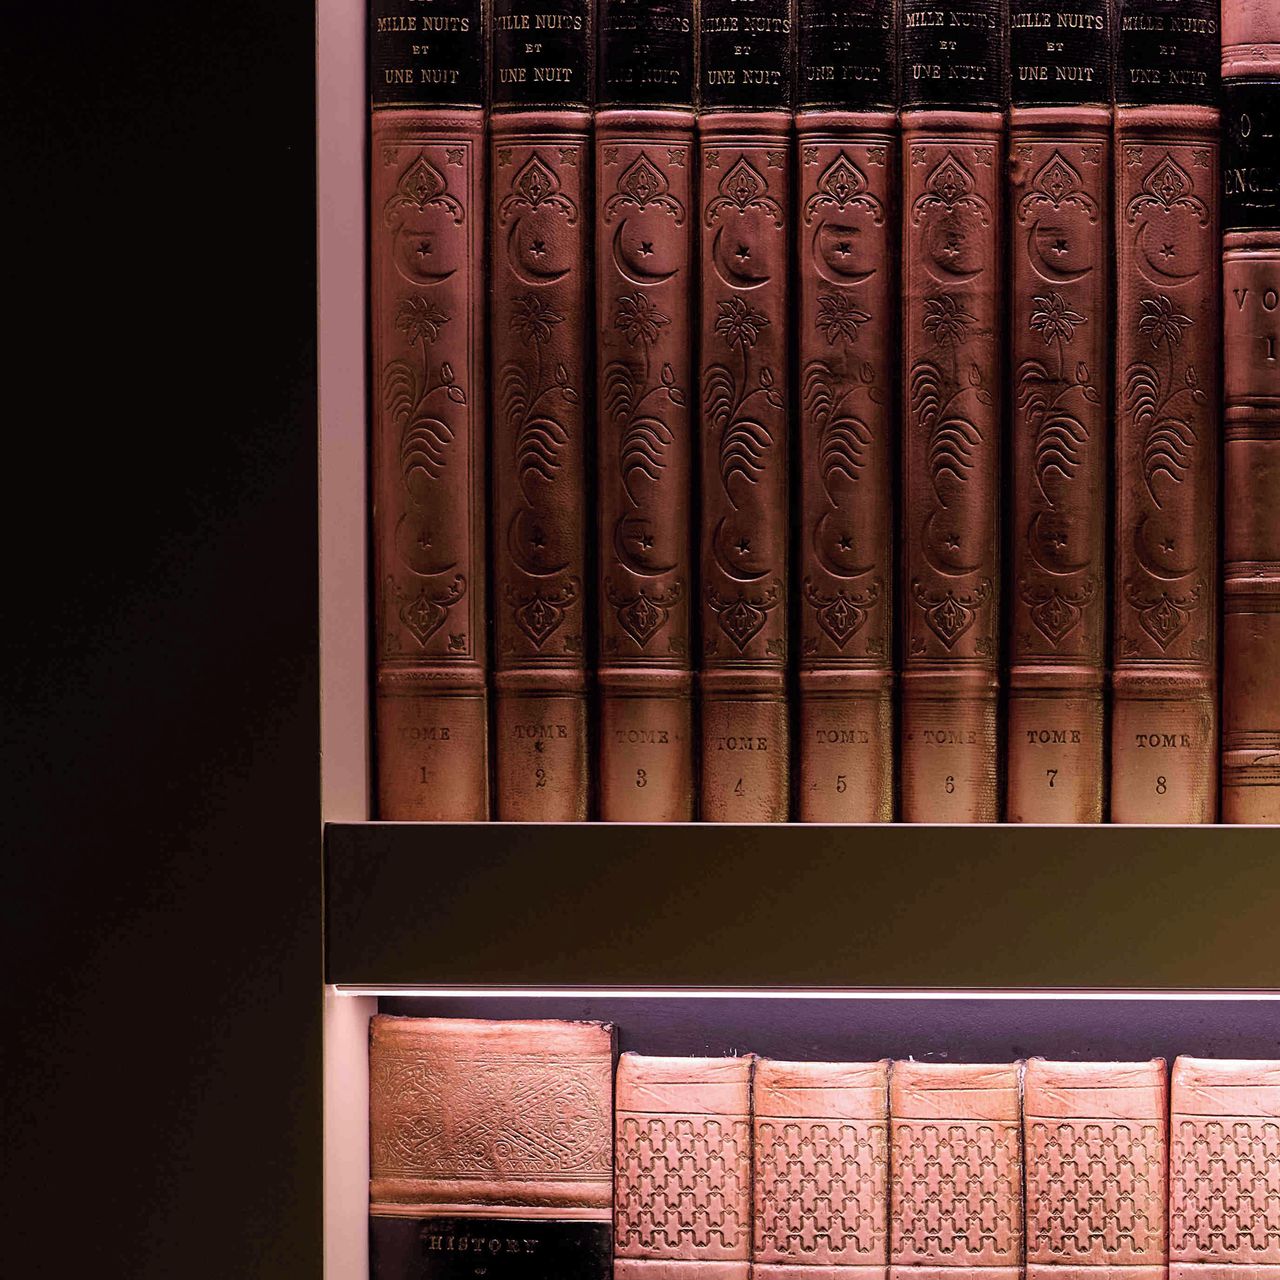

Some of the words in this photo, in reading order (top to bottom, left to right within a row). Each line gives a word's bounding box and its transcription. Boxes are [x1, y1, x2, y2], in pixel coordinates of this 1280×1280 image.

[377, 16, 416, 32] MILLE
[422, 16, 470, 32] NUITS
[905, 12, 944, 28] MILLE
[1011, 13, 1051, 29] MILLE
[1057, 13, 1104, 30] NUITS
[1122, 16, 1163, 31] MILLE
[1170, 17, 1216, 34] NUITS
[412, 45, 429, 55] ET
[525, 43, 542, 53] ET
[734, 45, 751, 55] ET
[939, 41, 957, 50] ET
[1046, 42, 1063, 52] ET
[1159, 45, 1177, 55] ET
[384, 70, 413, 84] UNE
[421, 69, 459, 84] NUIT
[500, 68, 527, 83] UNE
[533, 68, 573, 82] NUIT
[708, 70, 736, 85] UNE
[742, 70, 781, 85] NUIT
[912, 65, 941, 80] UNE
[1018, 66, 1048, 81] UNE
[1056, 67, 1094, 82] NUIT
[1130, 69, 1160, 84] UNE
[515, 724, 568, 740] TOME
[615, 729, 670, 745] TOME
[816, 729, 870, 746] TOME
[923, 729, 977, 745] TOME
[1026, 729, 1082, 745] TOME
[717, 736, 769, 752] TOME
[1135, 732, 1192, 749] TOME
[420, 766, 428, 784] 1
[535, 768, 547, 788] 2
[636, 768, 648, 789] 3
[1046, 768, 1058, 788] 7
[733, 777, 747, 798] 4
[836, 774, 848, 794] 5
[945, 775, 956, 795] 6
[1156, 775, 1168, 795] 8
[428, 1235, 540, 1254] HISTORY
